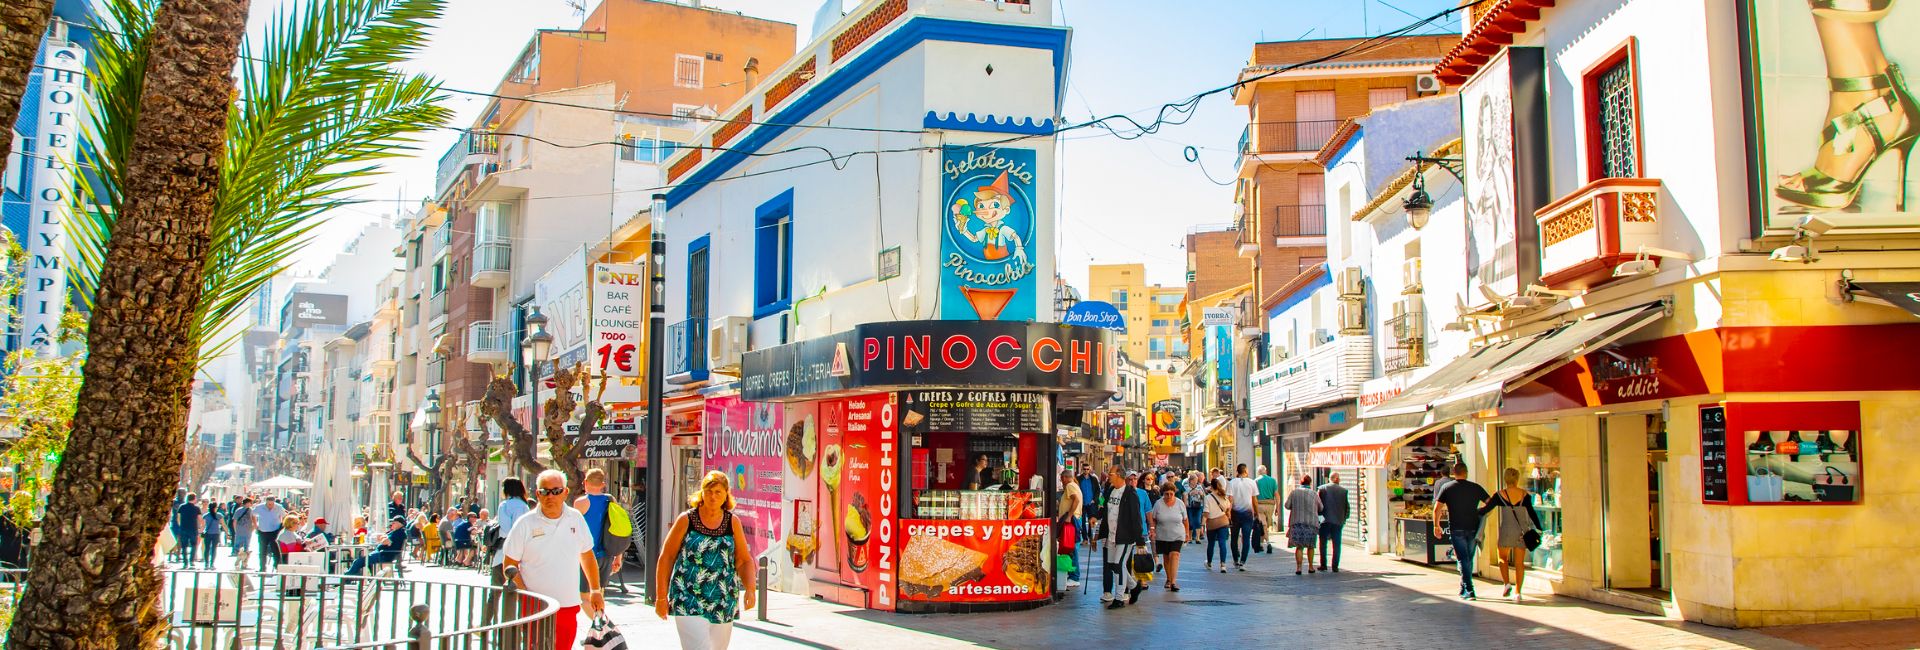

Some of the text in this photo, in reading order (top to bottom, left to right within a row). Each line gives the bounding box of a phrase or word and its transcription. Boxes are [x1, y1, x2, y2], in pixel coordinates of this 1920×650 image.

[32, 68, 73, 337] HOTEL OLYMPIA
[607, 291, 629, 300] BAR
[603, 305, 632, 315] CAFÉ
[594, 318, 639, 329] LOUNGE
[1067, 310, 1118, 326] Bon Bon Shop
[601, 332, 626, 341] TODO
[597, 343, 636, 372] 1€
[1618, 377, 1660, 398] addict
[919, 391, 953, 402] CREPES
[968, 391, 1006, 402] GOFRES
[585, 446, 619, 458] Churros
[879, 403, 893, 606] PINOCCHIO
[907, 521, 1049, 540] crepes y gofres
[948, 583, 1029, 595] artesanos
